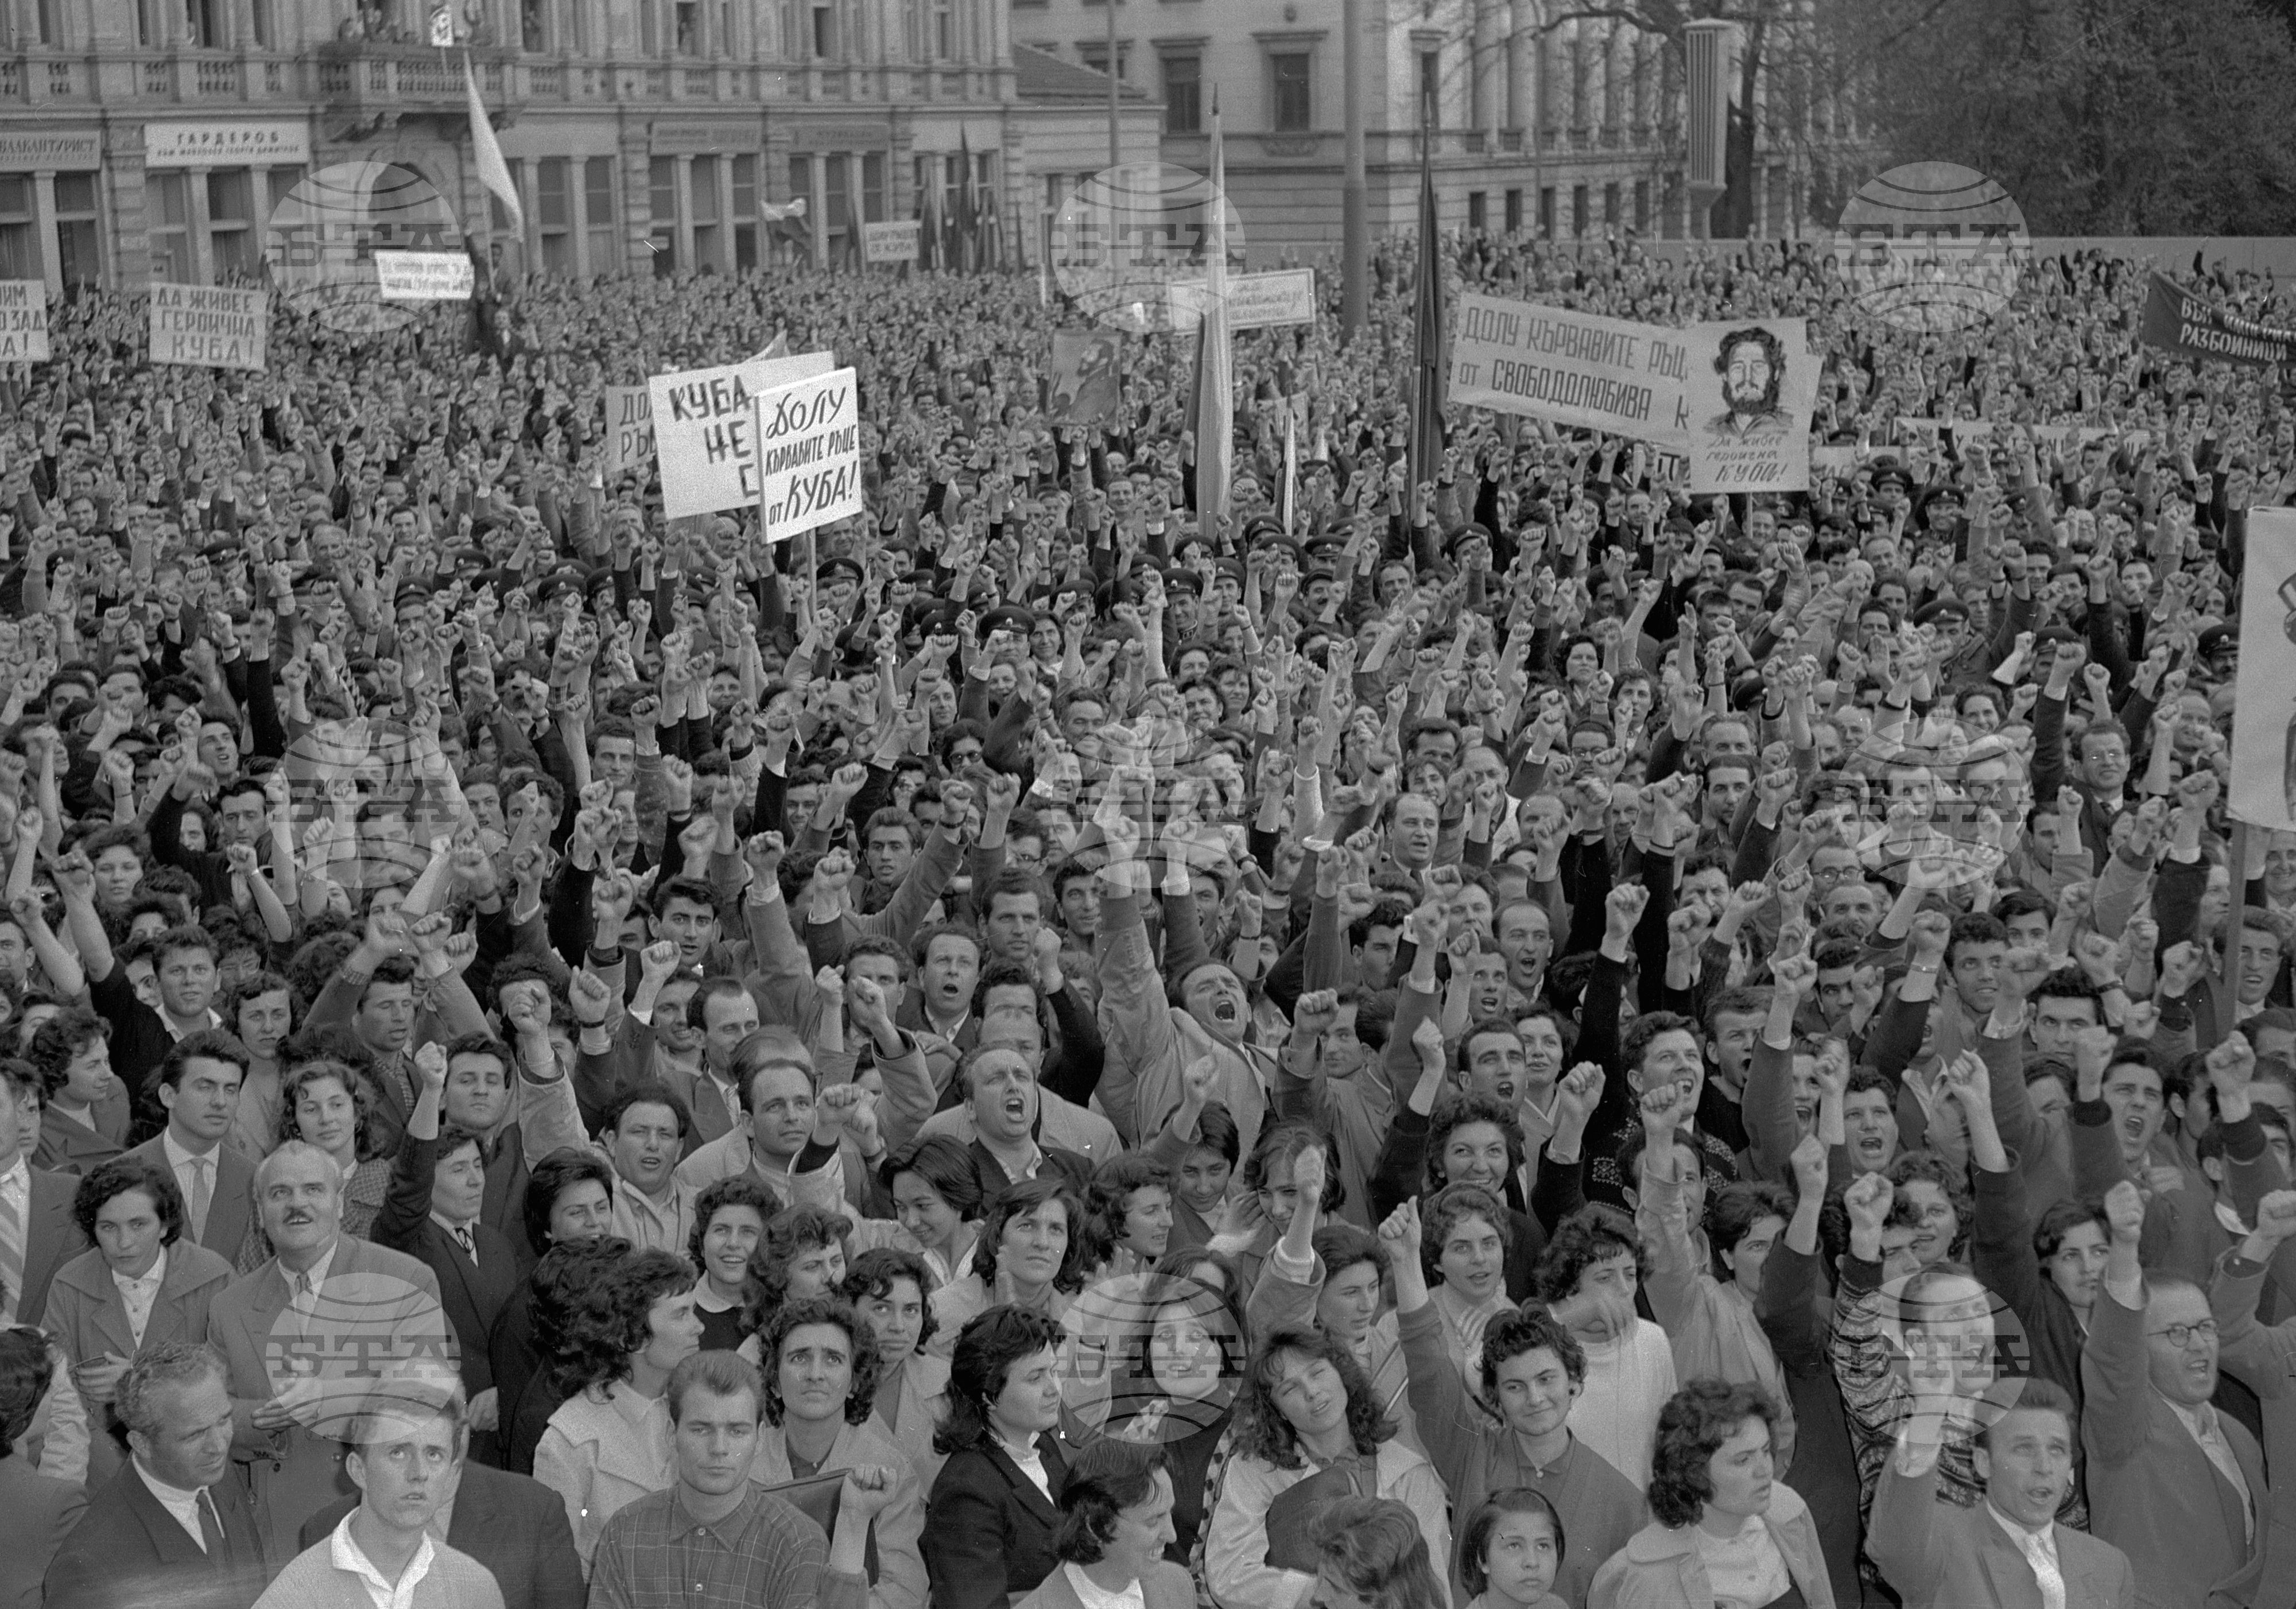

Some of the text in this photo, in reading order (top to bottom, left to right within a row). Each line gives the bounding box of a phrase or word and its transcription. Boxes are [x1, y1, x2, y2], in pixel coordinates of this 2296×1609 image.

[177, 131, 279, 145] ГАРДЕРОБ
[0, 286, 27, 306] ИМ
[157, 288, 253, 313] ДА ЖИВЕЕ
[161, 309, 255, 336] ГЕРОИЧНА
[1463, 307, 1688, 383] ДОЛУ КЪРВАВИТЕ РЪЦ
[173, 335, 253, 363] КУБА!
[669, 375, 752, 421] КУБА
[766, 386, 846, 439] ДОЛУ
[1491, 359, 1652, 421] СВОБОДОЛЮБИВА
[704, 420, 751, 464] НЕ
[765, 424, 856, 476] КЪРВАВИТЕ РЪЦЕ
[784, 460, 858, 523] КУБА!
